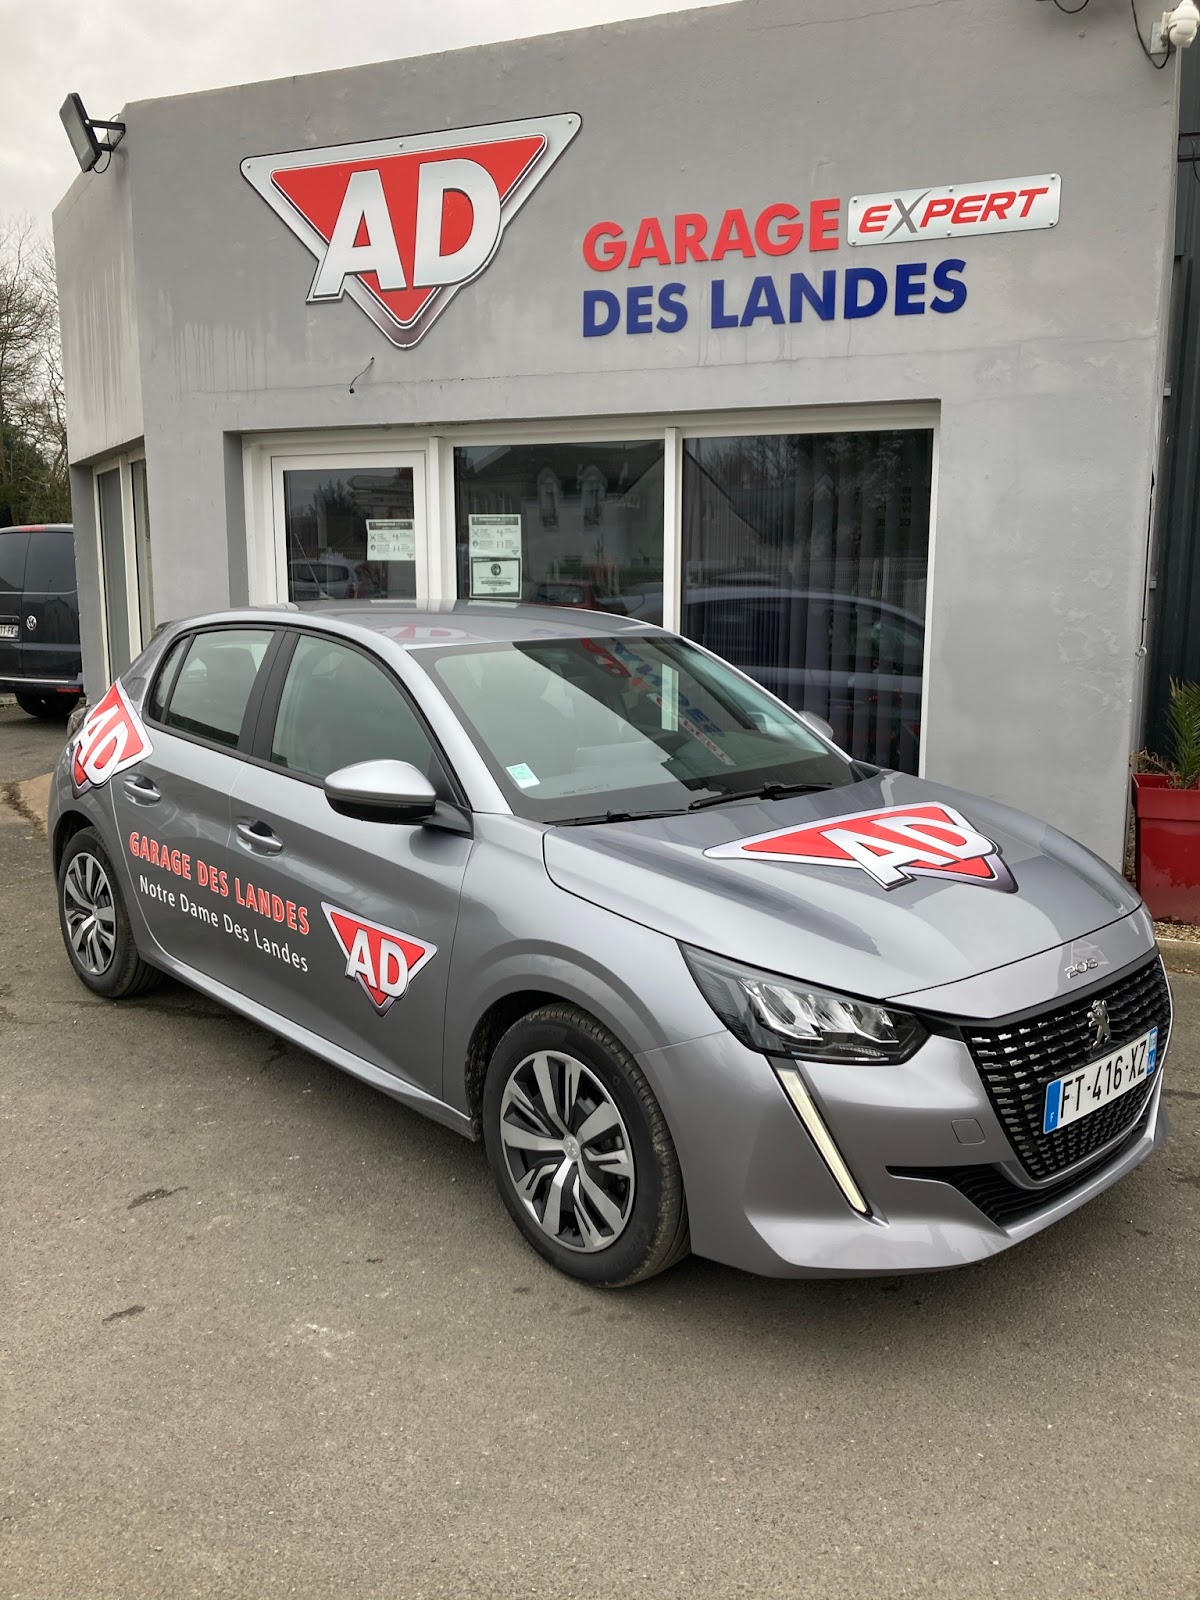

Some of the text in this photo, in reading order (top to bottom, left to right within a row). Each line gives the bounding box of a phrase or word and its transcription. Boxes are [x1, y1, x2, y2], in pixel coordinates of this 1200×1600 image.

[312, 158, 501, 298] AD
[582, 198, 841, 273] GARAGE
[582, 258, 968, 338] DES LANDES
[72, 704, 130, 785] AD
[129, 831, 311, 936] GARAGE DES LANDES
[818, 816, 994, 886] AD
[139, 874, 309, 973] Notre Dame Des Landes
[346, 928, 409, 999] AD
